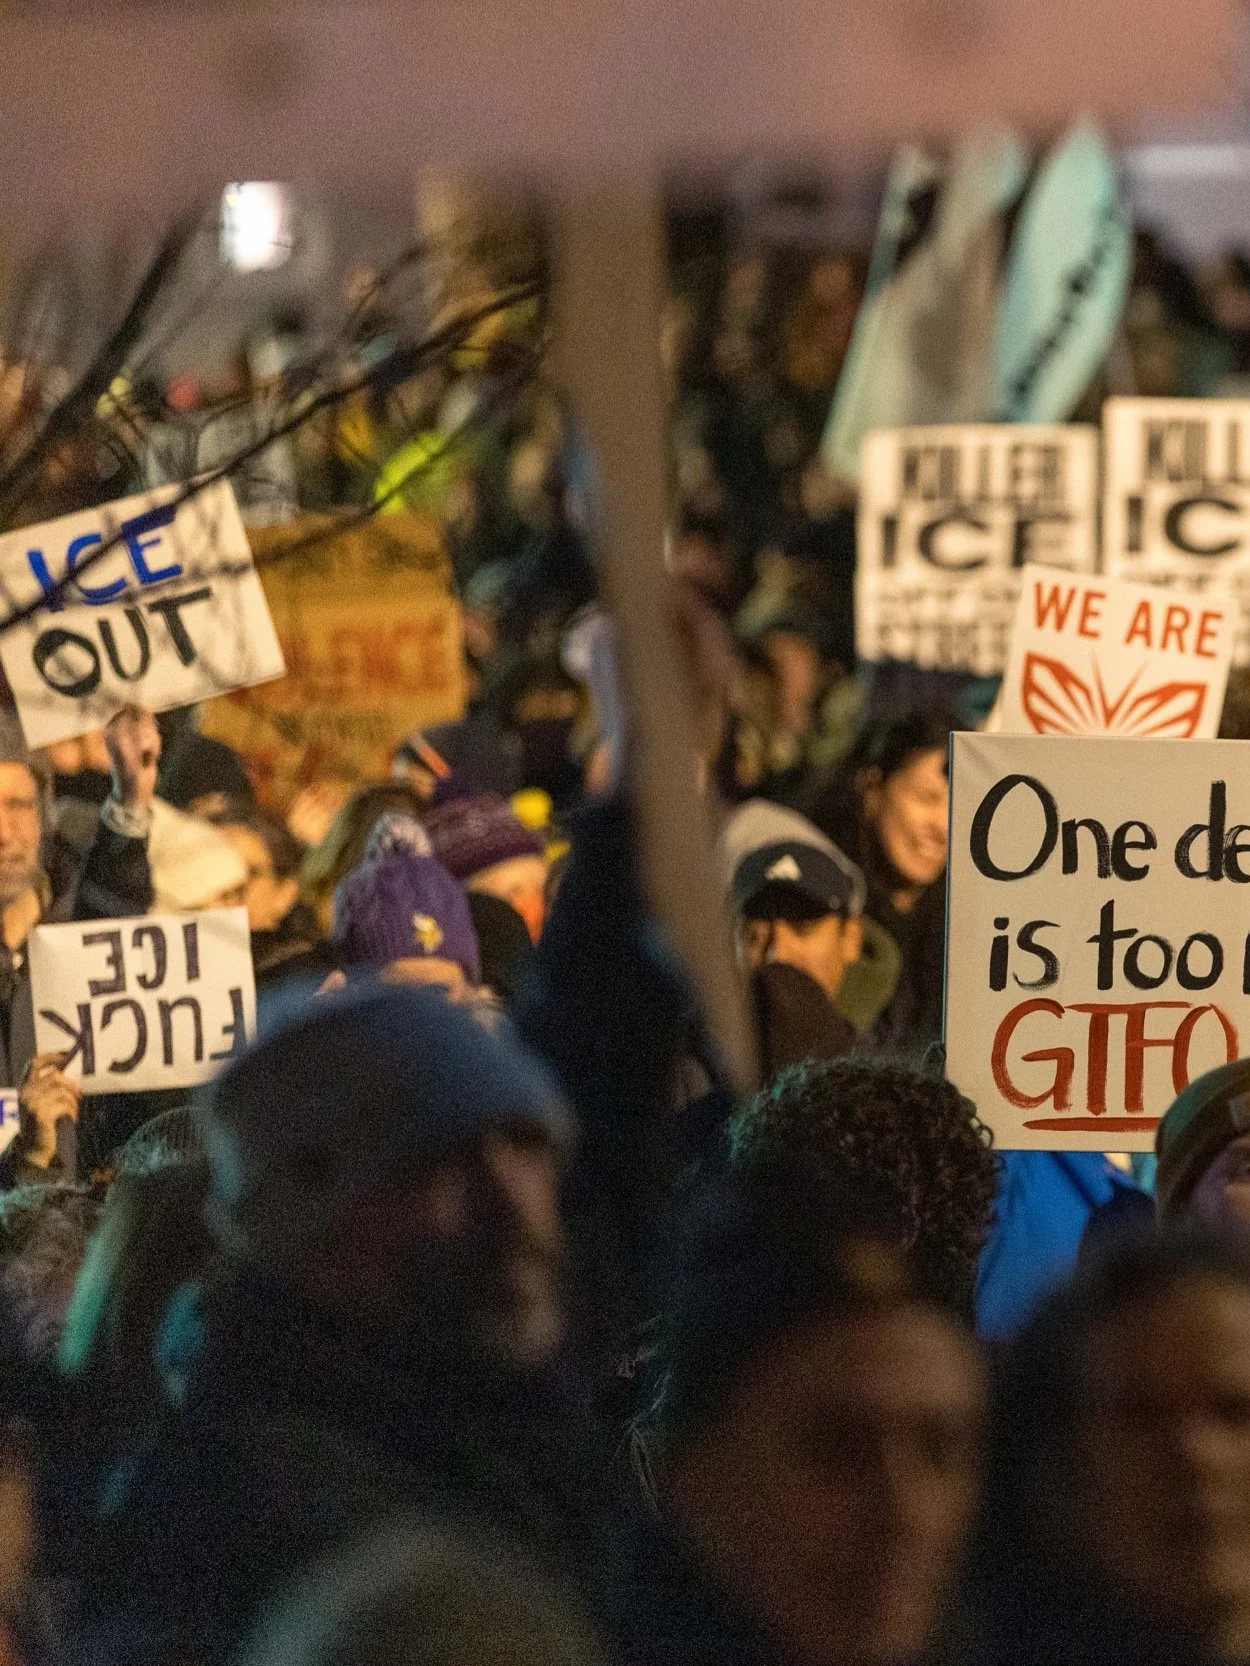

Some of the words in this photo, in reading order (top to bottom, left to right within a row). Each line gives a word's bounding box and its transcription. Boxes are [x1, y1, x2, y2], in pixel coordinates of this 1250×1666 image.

[27, 505, 184, 610] ICE
[881, 514, 1076, 572] ICE
[31, 587, 213, 697] OUT
[1033, 582, 1105, 640] WE
[1125, 599, 1224, 658] ARE
[970, 774, 1156, 881] One
[82, 922, 201, 997] ICE
[988, 916, 1060, 991] is
[1085, 899, 1224, 991] too
[39, 987, 248, 1076] FUCK
[990, 997, 1239, 1116] GTFO
